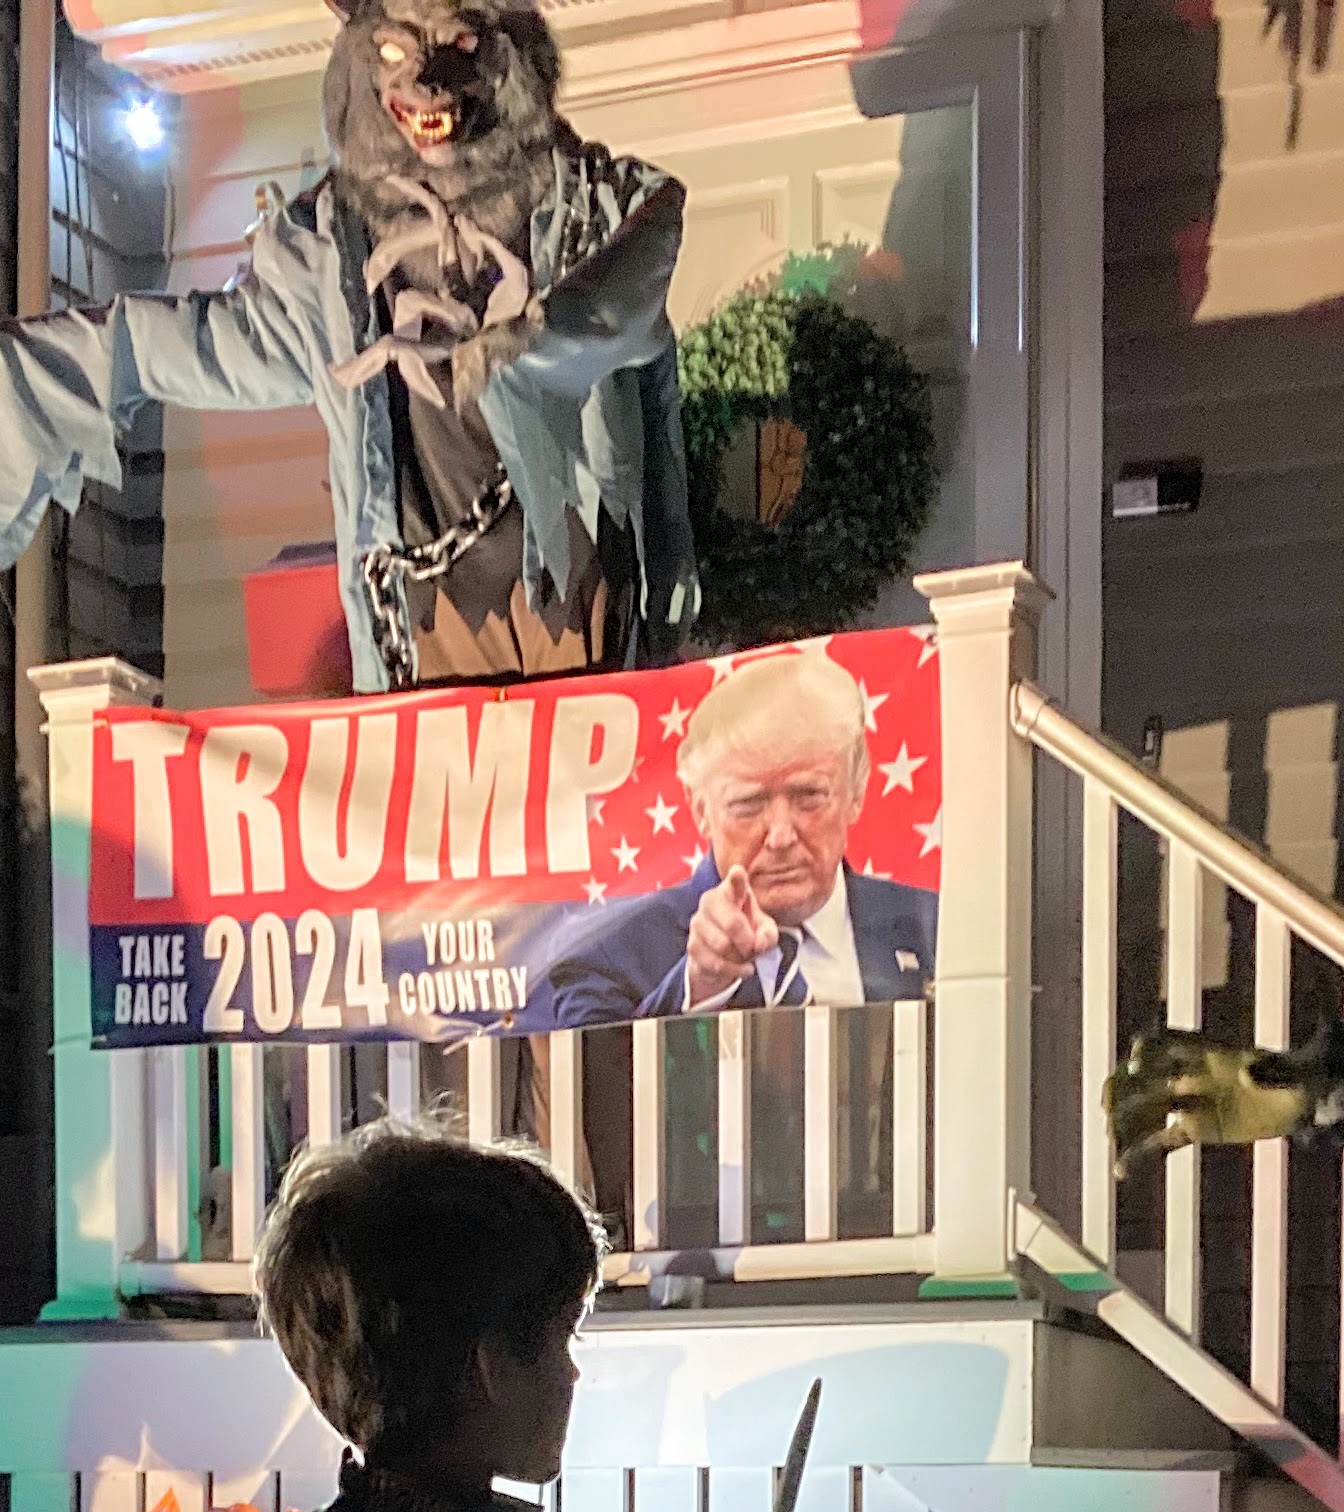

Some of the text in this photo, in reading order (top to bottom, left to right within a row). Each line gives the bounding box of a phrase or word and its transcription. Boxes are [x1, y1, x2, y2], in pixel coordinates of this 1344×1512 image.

[111, 693, 639, 899] TRUMP
[119, 936, 186, 978] TAKE
[422, 919, 494, 965] YOUR
[203, 908, 389, 1033] 2024
[399, 967, 528, 1015] COUNTRY
[114, 983, 188, 1025] BACK
